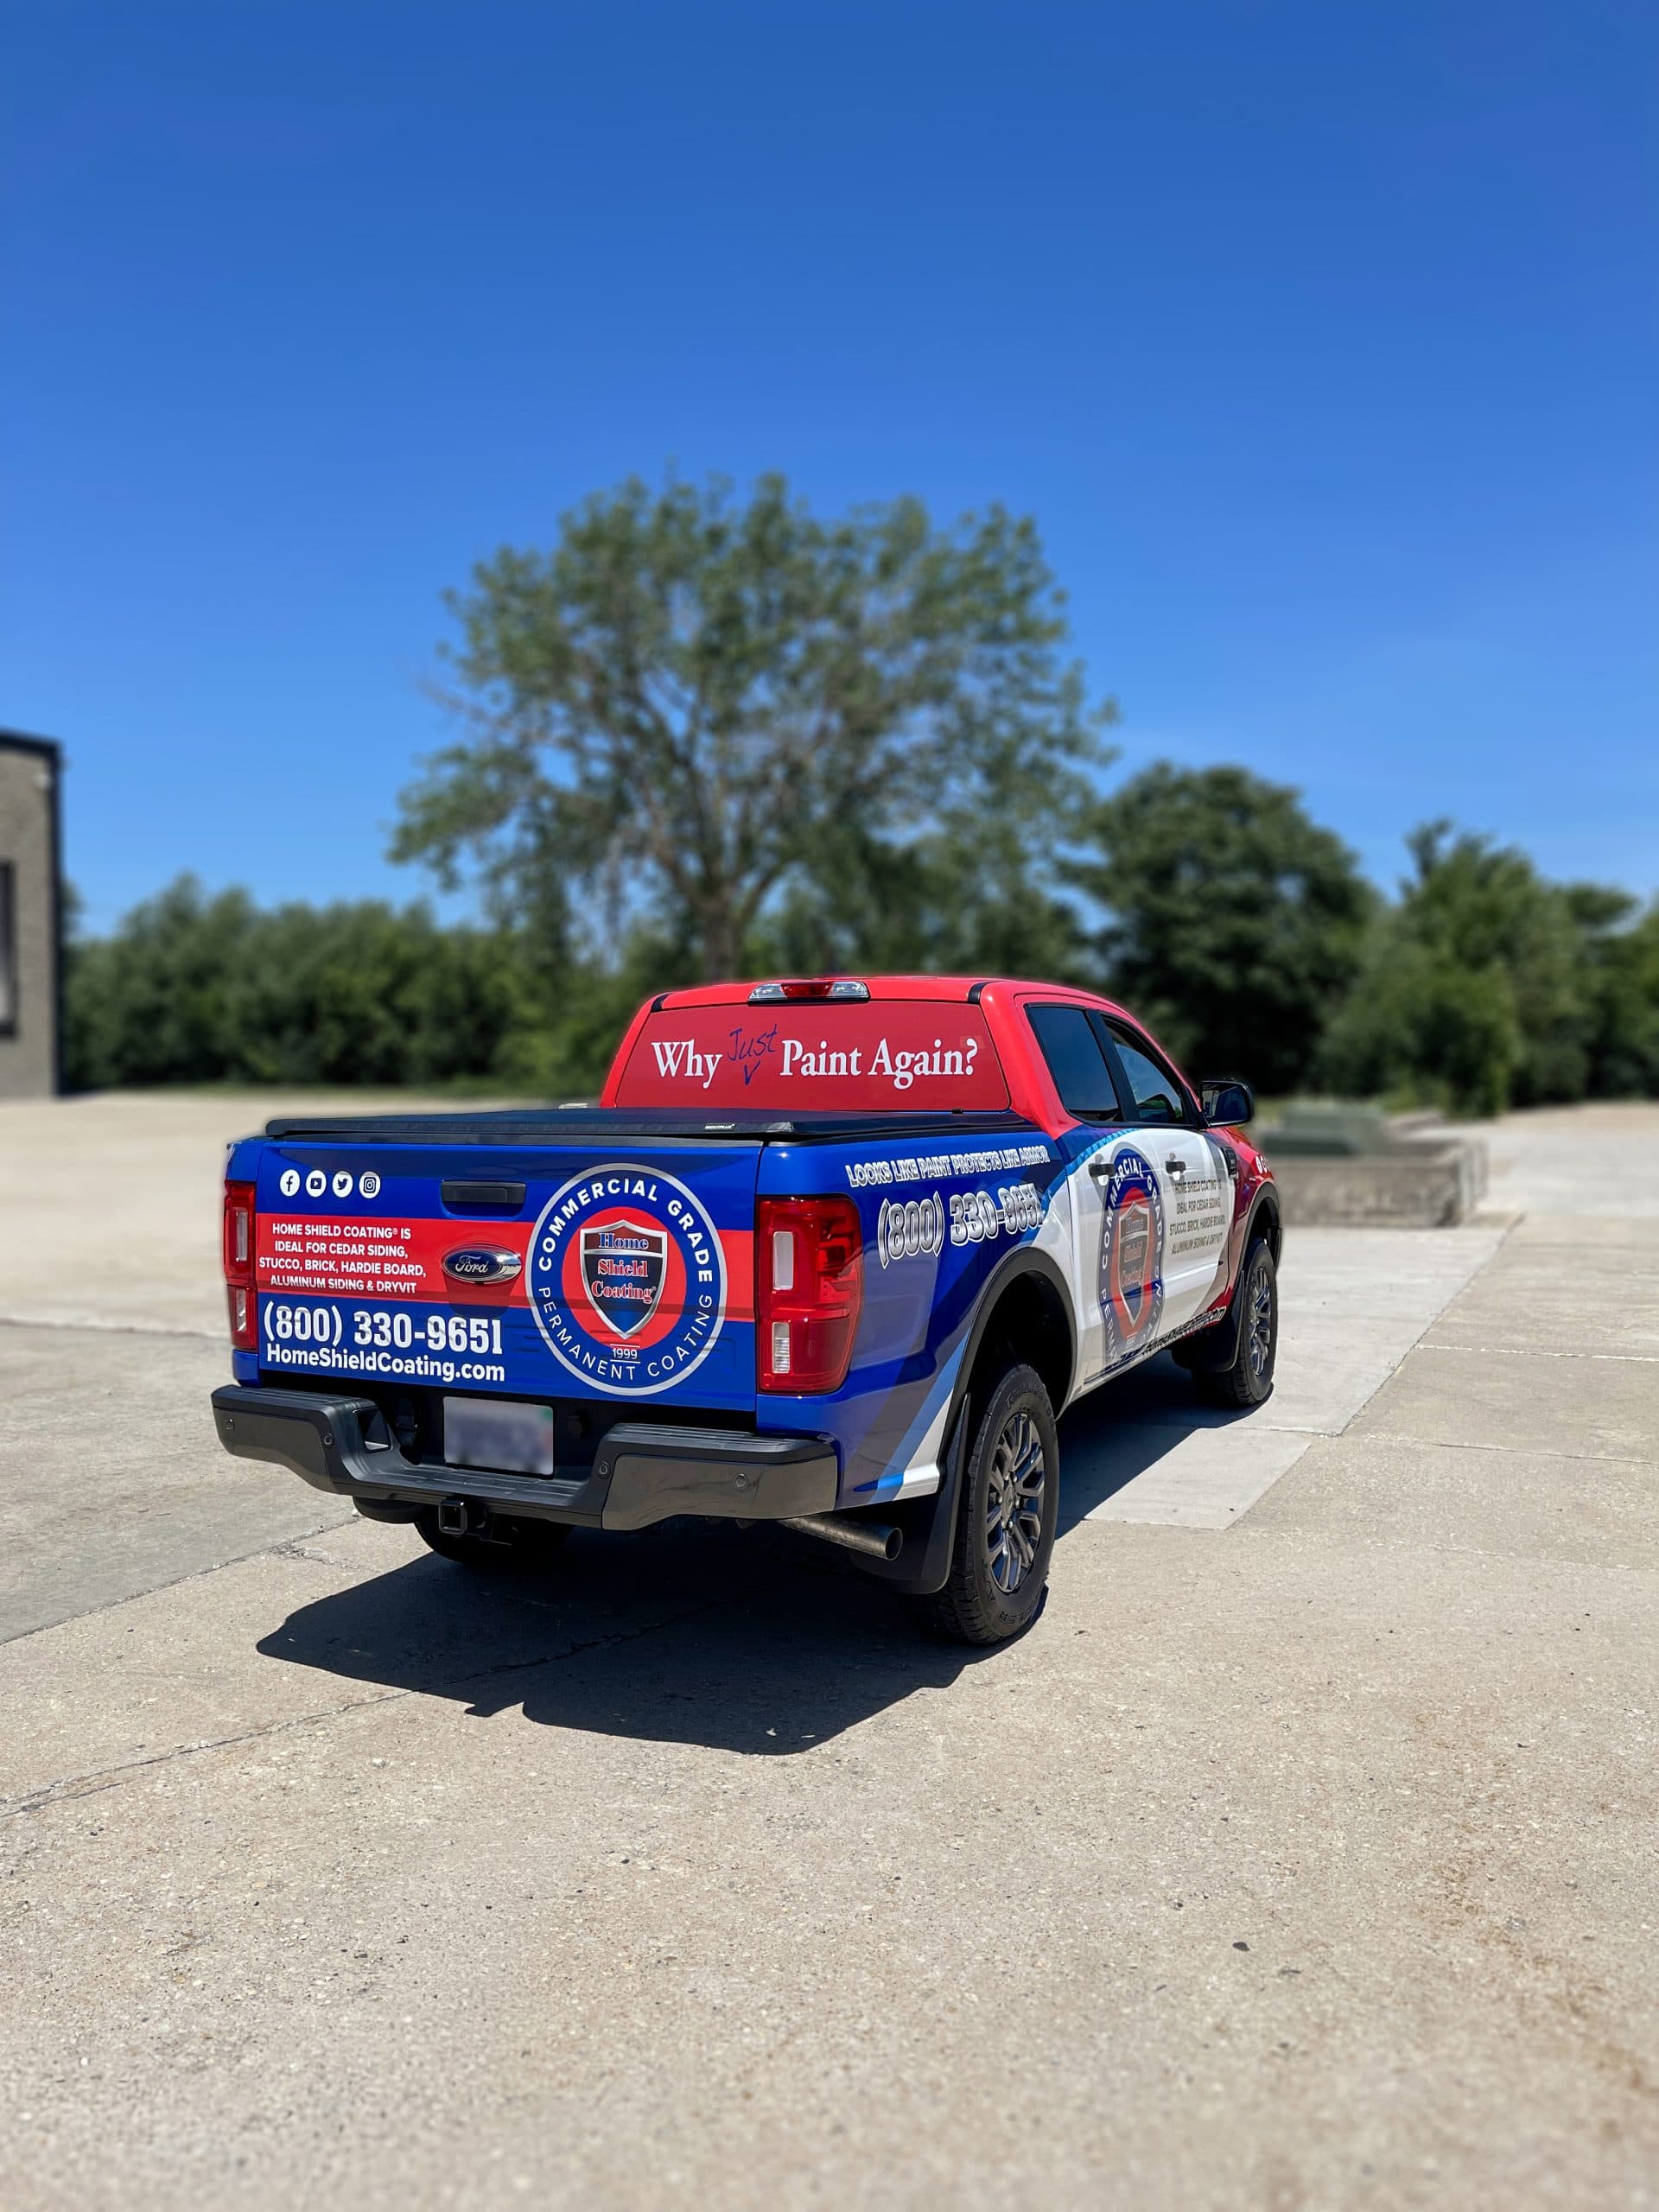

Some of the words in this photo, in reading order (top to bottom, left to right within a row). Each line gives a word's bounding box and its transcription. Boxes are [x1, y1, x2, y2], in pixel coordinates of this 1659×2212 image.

[651, 1039, 722, 1089] Why
[727, 1023, 778, 1062] Just
[779, 1039, 862, 1077] Paint
[868, 1038, 978, 1090] Again?
[845, 1160, 893, 1188] LOOKS
[892, 1158, 919, 1182] LIKE
[918, 1155, 951, 1179] PAINT
[998, 1148, 1021, 1170] LIKE
[272, 1223, 302, 1236] HOME
[304, 1224, 341, 1236] SHIELD
[400, 1228, 411, 1240] IS
[538, 1178, 658, 1271] COMMERCIAL
[667, 1199, 713, 1282] GRADE
[598, 1232, 649, 1249] Home
[878, 1190, 944, 1270] (800)
[275, 1241, 303, 1253] IDEAL
[306, 1242, 327, 1254] FOR
[329, 1243, 365, 1255] CEDAR
[367, 1245, 409, 1259] SIDING,
[259, 1257, 302, 1271] STUCCO,
[305, 1259, 339, 1274] BRICK,
[341, 1261, 381, 1274] HARDIE
[384, 1263, 427, 1278] BOARD,
[454, 1255, 489, 1273] Ford
[597, 1259, 648, 1278] Shield
[270, 1274, 326, 1288] ALUMINUM
[328, 1278, 365, 1291] SIDING
[366, 1280, 374, 1292] &
[376, 1281, 417, 1294] DRYVIT
[264, 1300, 343, 1347] (800)
[353, 1310, 503, 1355] 330-9651
[538, 1287, 635, 1380] PERMANENT
[648, 1294, 713, 1377] COATING
[266, 1343, 505, 1382] HomeShieldCoating.com
[612, 1348, 638, 1360] 1999
